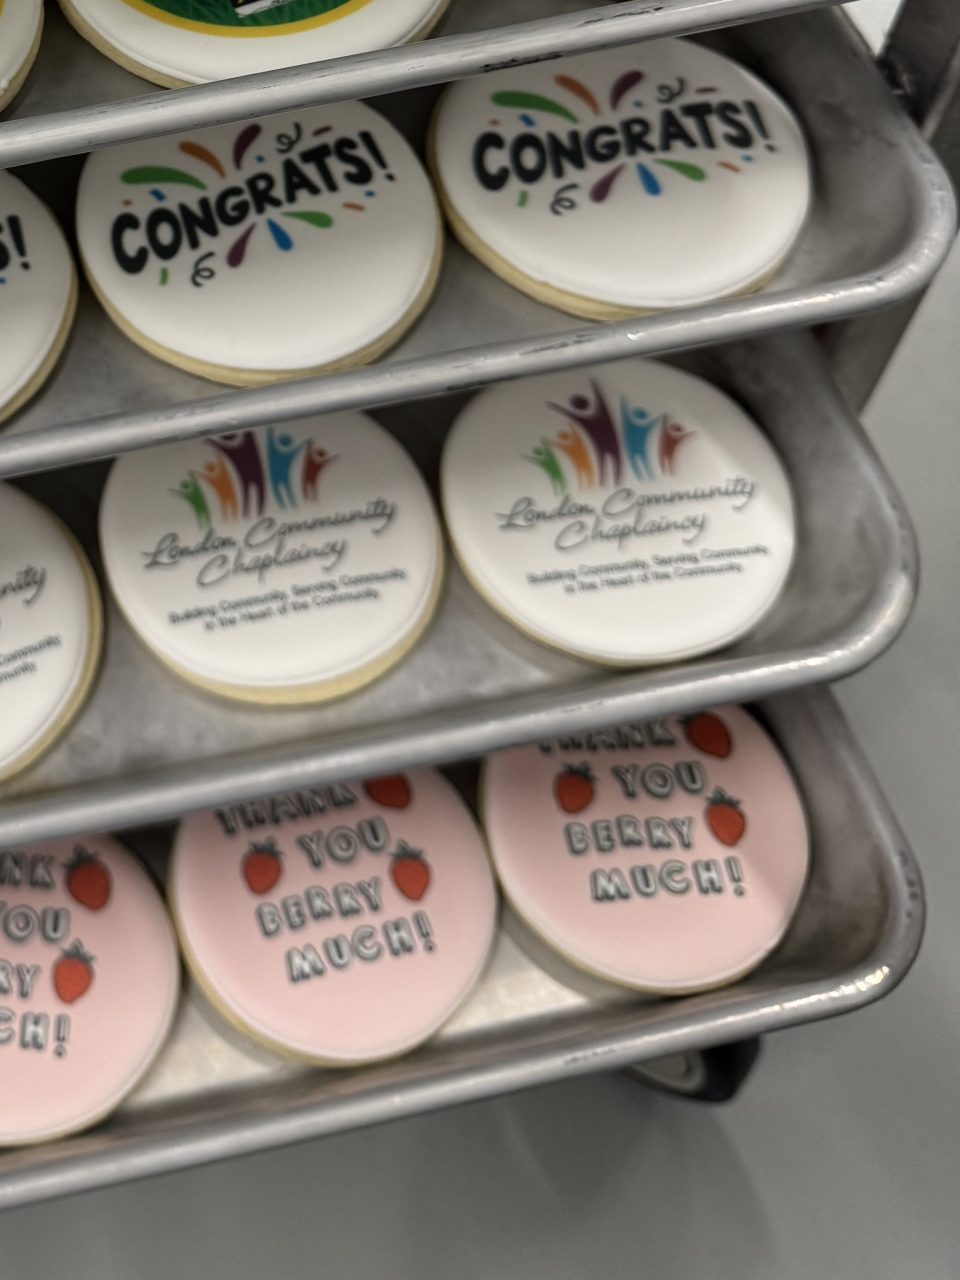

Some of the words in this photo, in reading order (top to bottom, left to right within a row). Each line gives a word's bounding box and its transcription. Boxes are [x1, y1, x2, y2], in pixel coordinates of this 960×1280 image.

[472, 99, 778, 192] CONGRATS!
[110, 130, 395, 274] CONGRATS!
[495, 494, 595, 531] London
[602, 477, 757, 517] Community
[142, 527, 237, 568] London
[244, 497, 397, 548] Community
[554, 511, 708, 551] Chaplaincy
[196, 536, 349, 588] Chaplaincy
[612, 761, 705, 799] YOU
[297, 816, 389, 868] YOU
[564, 815, 693, 855] BERRY
[593, 855, 745, 902] MUCH!
[256, 877, 382, 938] BERRY
[286, 910, 435, 984] MUCH!
